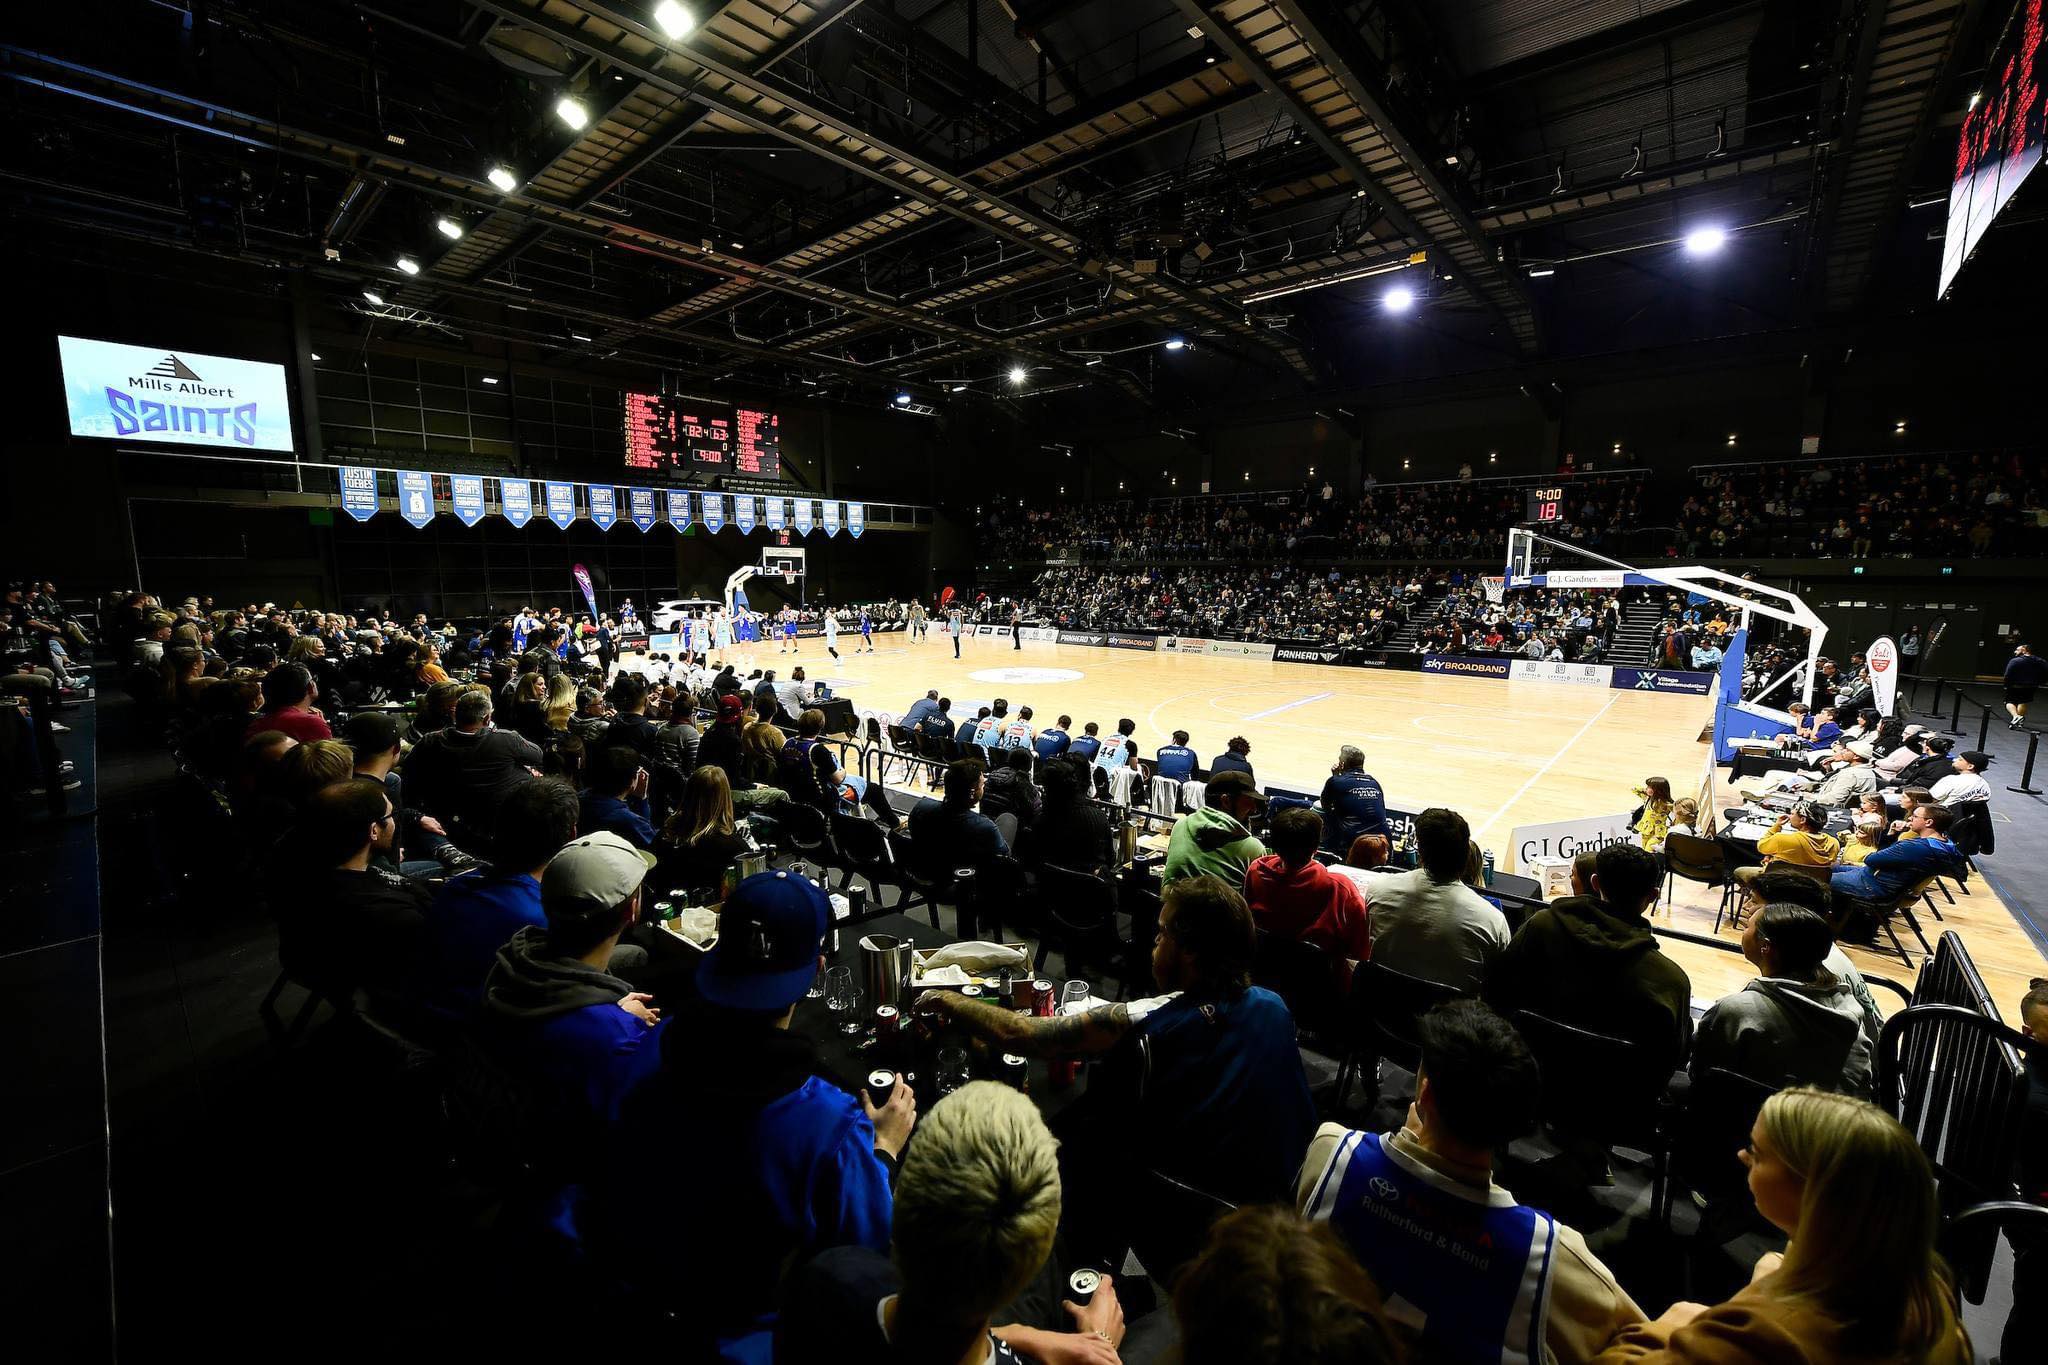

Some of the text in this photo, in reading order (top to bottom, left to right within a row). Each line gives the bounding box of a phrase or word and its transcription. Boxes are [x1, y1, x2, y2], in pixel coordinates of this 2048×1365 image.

[128, 377, 235, 398] Mills Albert
[689, 426, 702, 438] 82
[713, 430, 726, 440] 63
[700, 450, 722, 462] 9:00
[344, 468, 373, 480] JUSTIN
[455, 485, 480, 495] SAINTS
[505, 488, 528, 498] SAINTS
[549, 491, 571, 500] SAINTS
[1536, 489, 1562, 500] 9:00
[592, 494, 612, 502] SAINTS
[1540, 503, 1556, 519] 18
[1060, 634, 1089, 643] PANHEAD
[1109, 636, 1154, 647] sky BROADBAND
[1277, 649, 1319, 660] PANHEAD
[1424, 658, 1507, 674] sky BROADBAND
[1657, 681, 1707, 689] Accommodation
[927, 715, 946, 727] FLUID
[977, 730, 985, 739] 5
[1008, 735, 1020, 747] 13
[1100, 746, 1115, 759] 44
[1361, 1194, 1434, 1243] Rutherford
[1436, 1233, 1448, 1249] &
[1452, 1241, 1489, 1273] Bond
